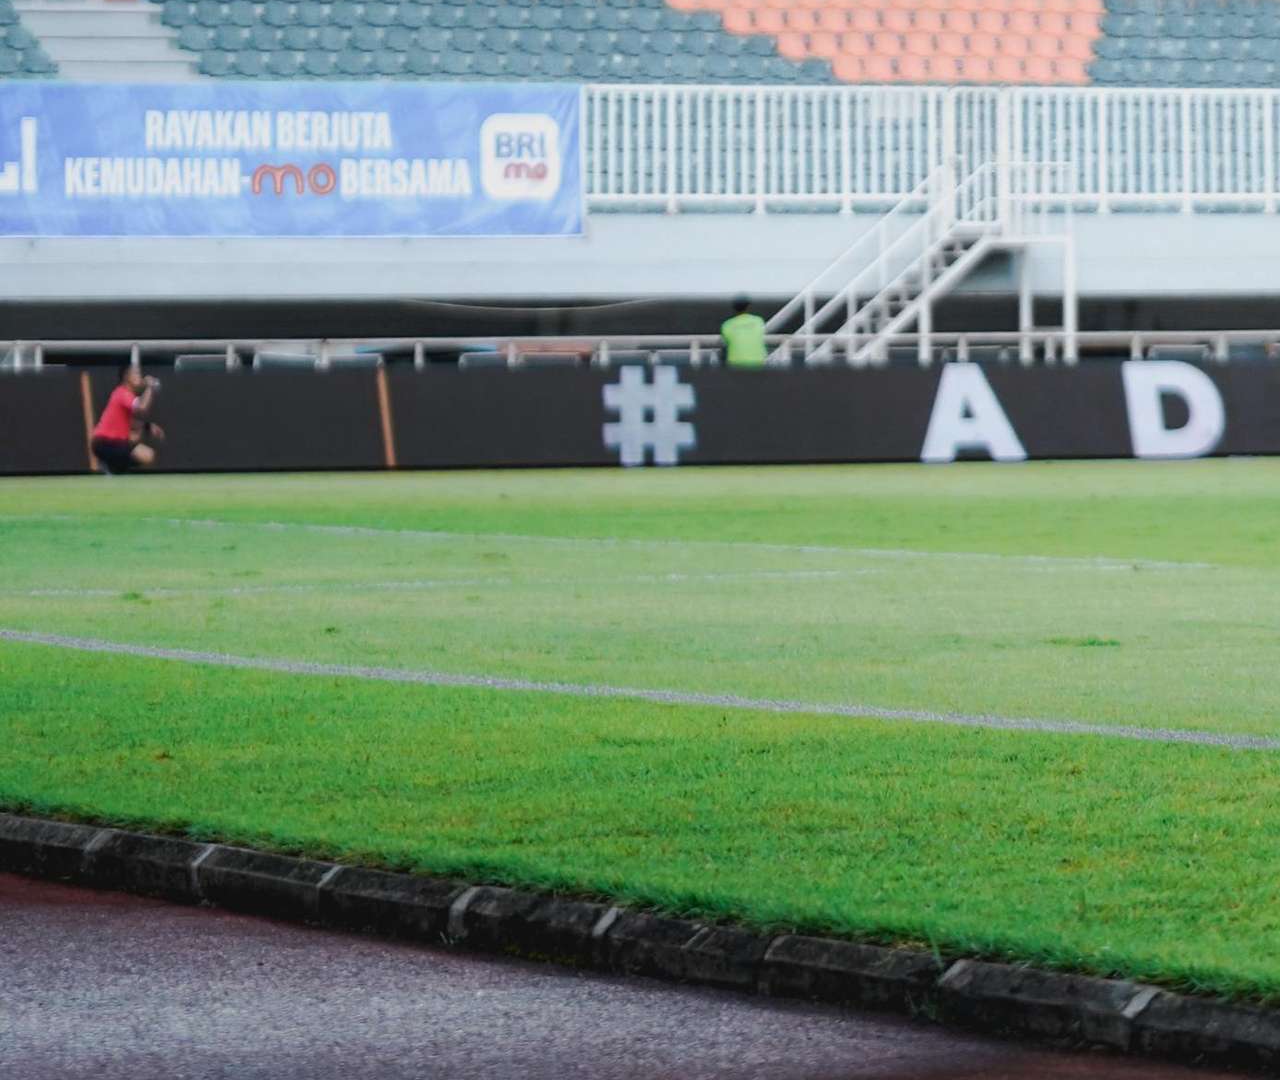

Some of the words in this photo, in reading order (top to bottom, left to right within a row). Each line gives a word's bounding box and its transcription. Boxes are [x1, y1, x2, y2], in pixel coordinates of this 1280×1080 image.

[145, 110, 271, 149] RAYAKAN
[275, 111, 393, 150] BERJUTA
[494, 132, 546, 159] BRI
[339, 158, 473, 196] BERSAMA
